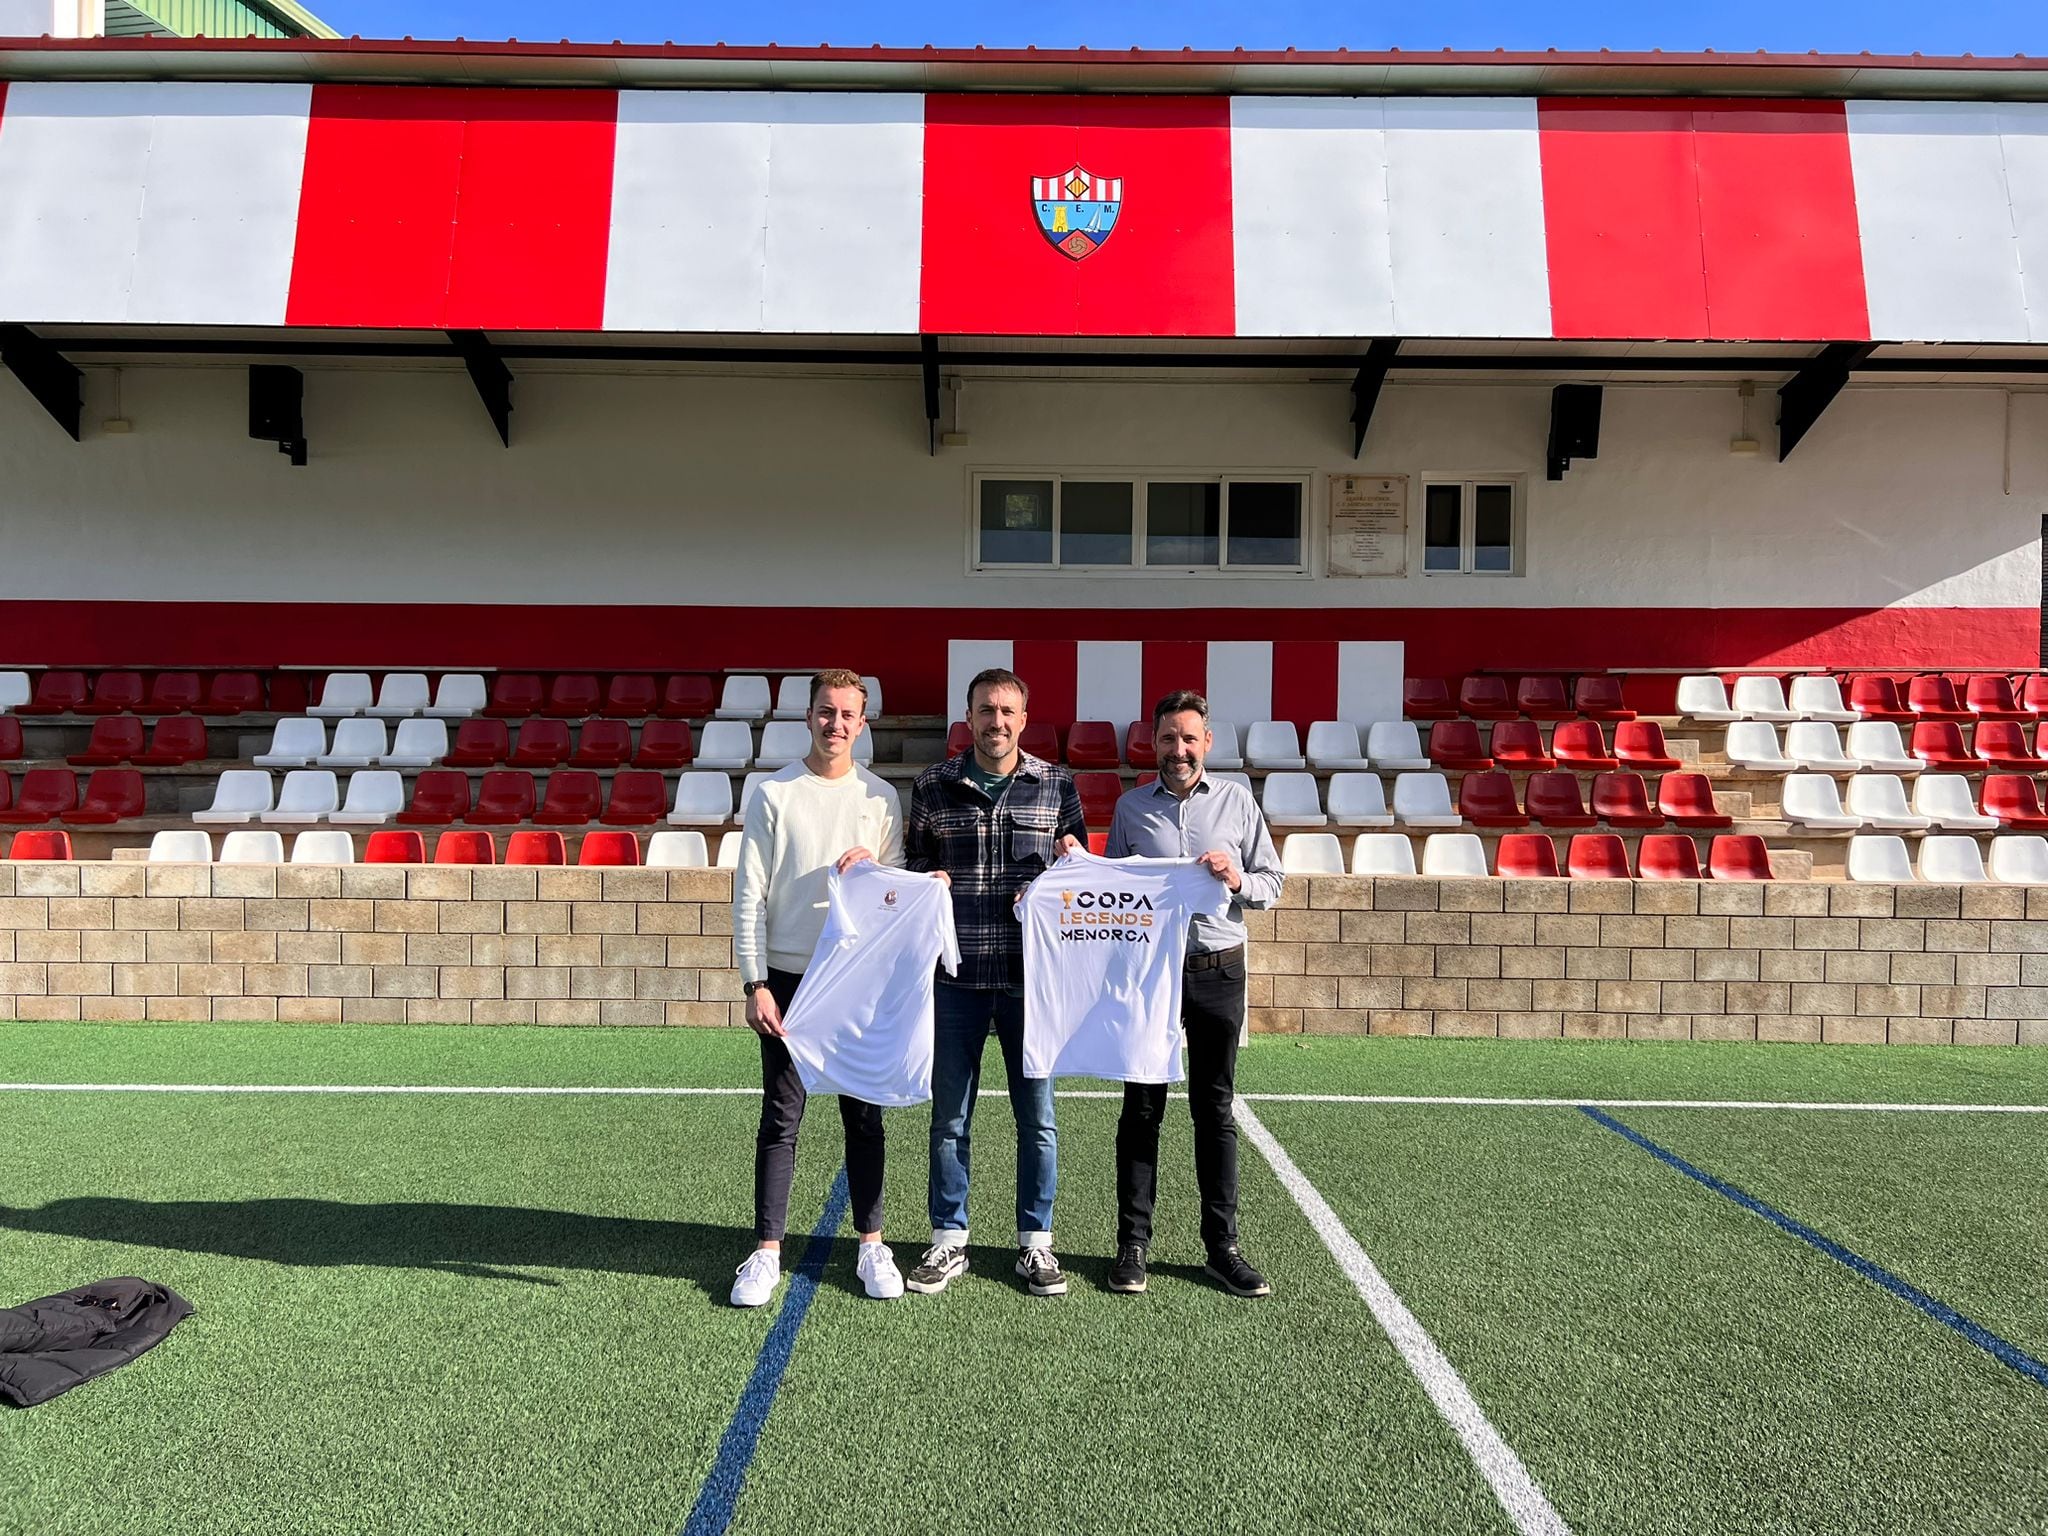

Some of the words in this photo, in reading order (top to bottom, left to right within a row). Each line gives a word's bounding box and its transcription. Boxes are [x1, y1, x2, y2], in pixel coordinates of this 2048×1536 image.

[1077, 891, 1154, 910] COPA
[1060, 912, 1153, 927] LEGENDS
[1061, 929, 1150, 943] MENORCA
